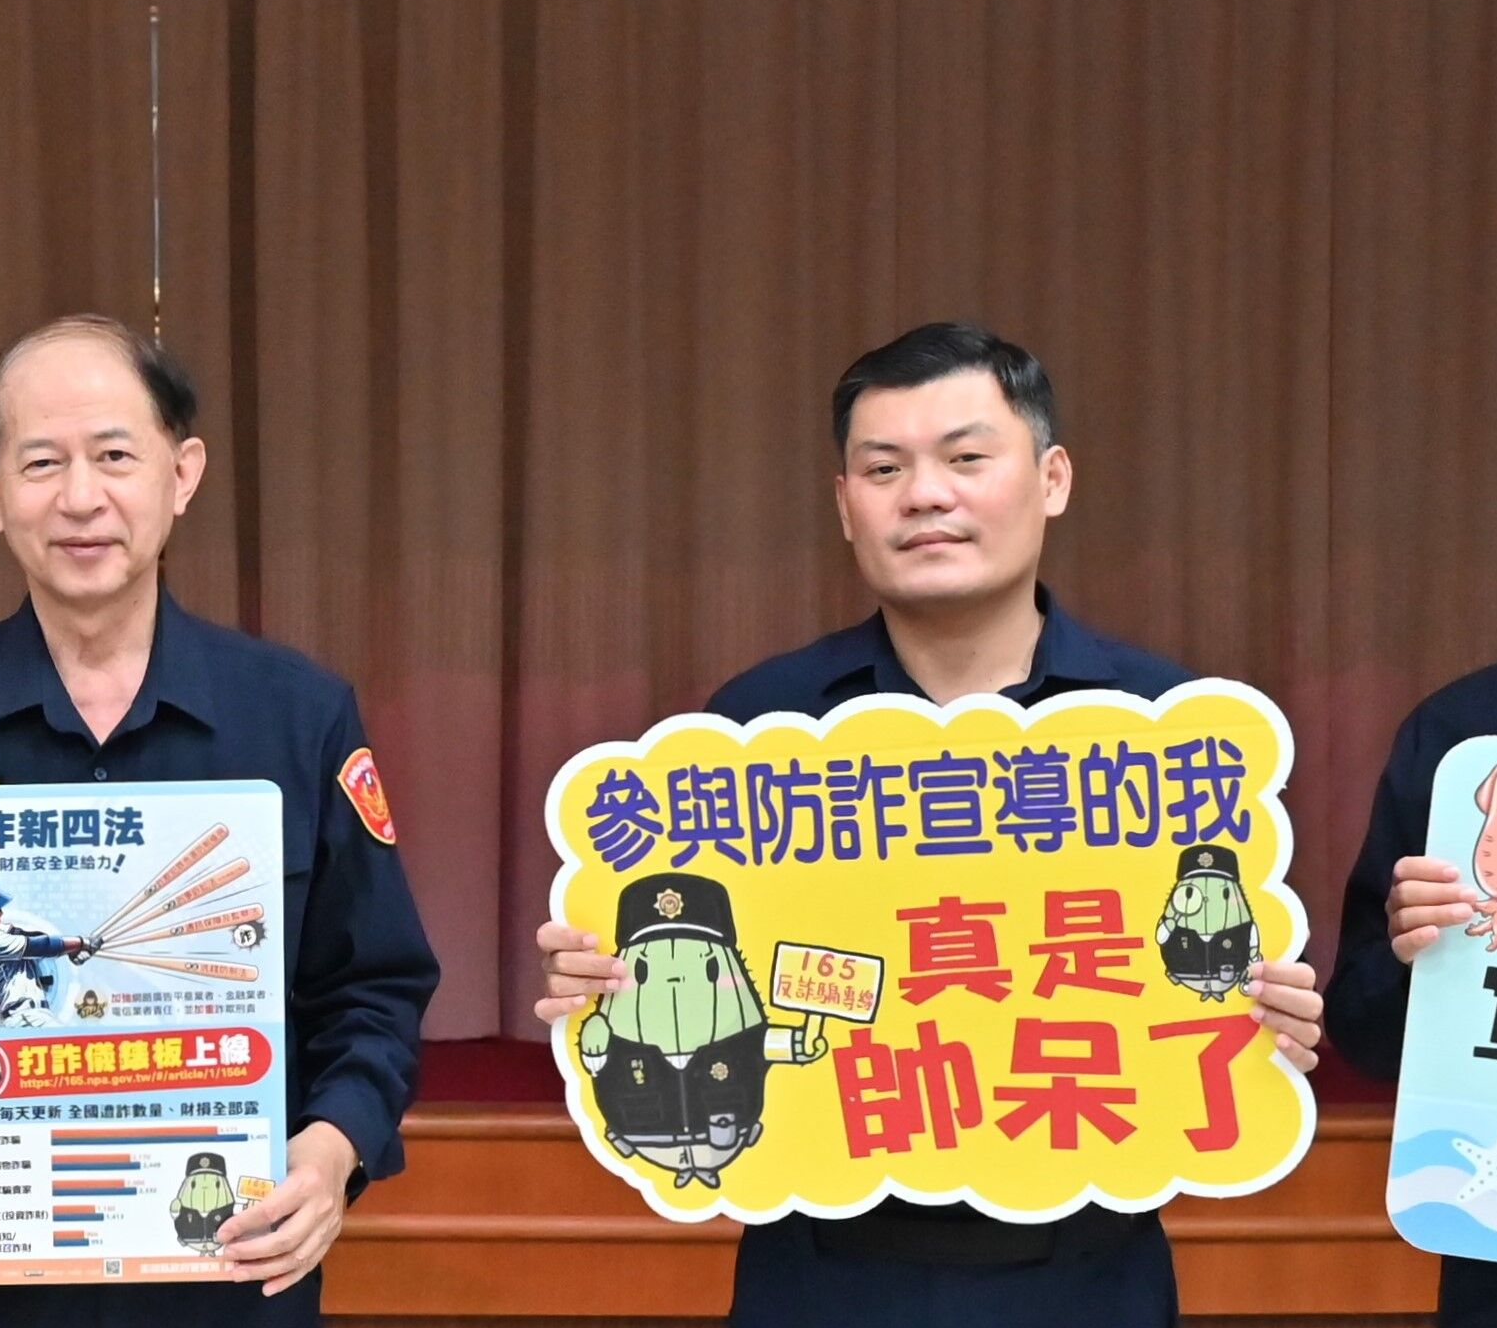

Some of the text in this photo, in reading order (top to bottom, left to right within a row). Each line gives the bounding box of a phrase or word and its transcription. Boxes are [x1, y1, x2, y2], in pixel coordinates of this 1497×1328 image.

[586, 736, 1250, 872] 參與防詐宣導的我
[802, 951, 856, 980] 165
[896, 889, 1145, 1005] 真是
[776, 974, 874, 1010] 反詐騙專線
[18, 1034, 251, 1076] 打詐儀錶板上線
[833, 1013, 1262, 1159] 帥呆了
